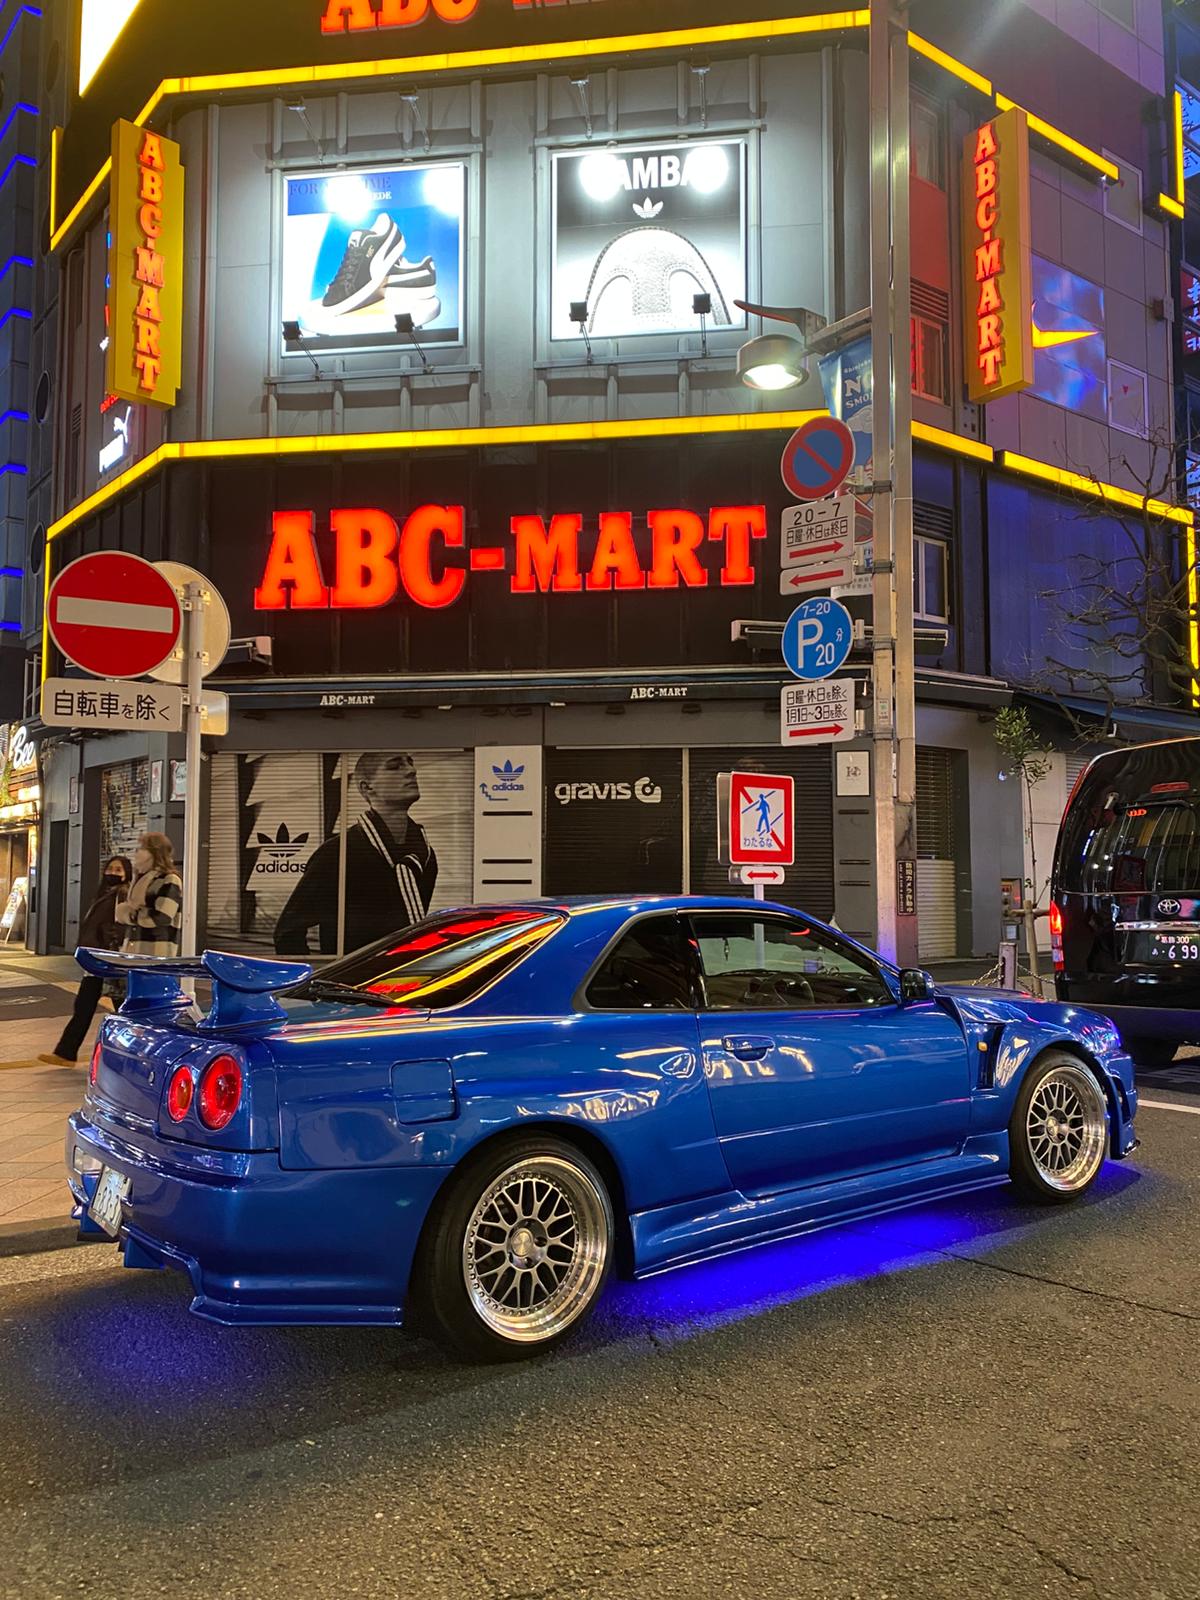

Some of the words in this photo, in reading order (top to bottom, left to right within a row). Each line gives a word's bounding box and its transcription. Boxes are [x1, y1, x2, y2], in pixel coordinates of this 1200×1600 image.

[136, 132, 165, 391] ABC-MART
[974, 123, 1002, 385] ABC-MART
[846, 393, 872, 408] SMO
[254, 504, 767, 610] ABC-MART
[802, 601, 831, 618] 7-20
[797, 617, 824, 669] P
[815, 642, 835, 667] 20
[320, 694, 375, 706] ABC-MART
[630, 687, 688, 699] ABC-MART
[54, 689, 170, 721] 自転車を除く
[491, 782, 525, 792] adidas
[554, 782, 632, 805] gravis
[743, 837, 773, 848] わたるな
[256, 860, 308, 873] adidas
